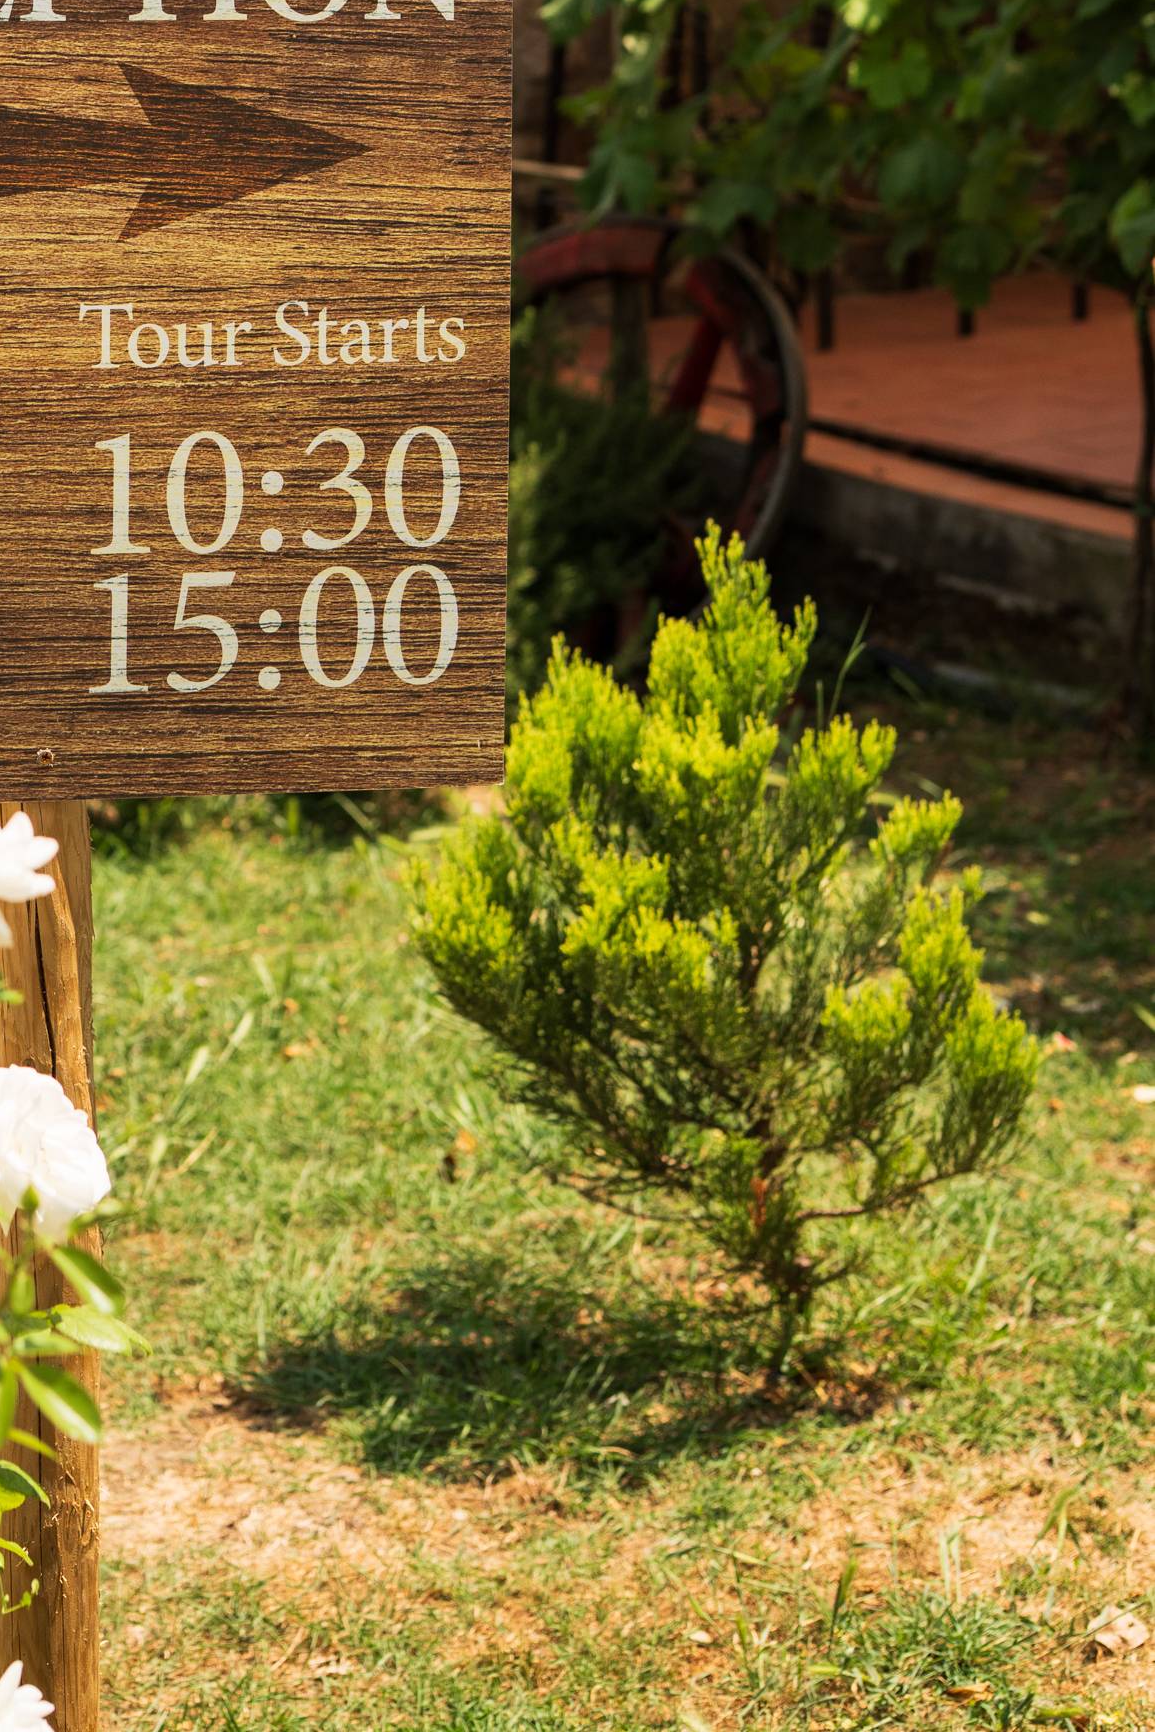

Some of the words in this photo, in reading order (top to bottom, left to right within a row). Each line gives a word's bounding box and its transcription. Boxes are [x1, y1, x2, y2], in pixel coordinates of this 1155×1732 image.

[79, 304, 255, 371] Tour
[274, 300, 468, 367] Starts
[90, 425, 462, 557] 10:30
[89, 563, 459, 696] 15:00
